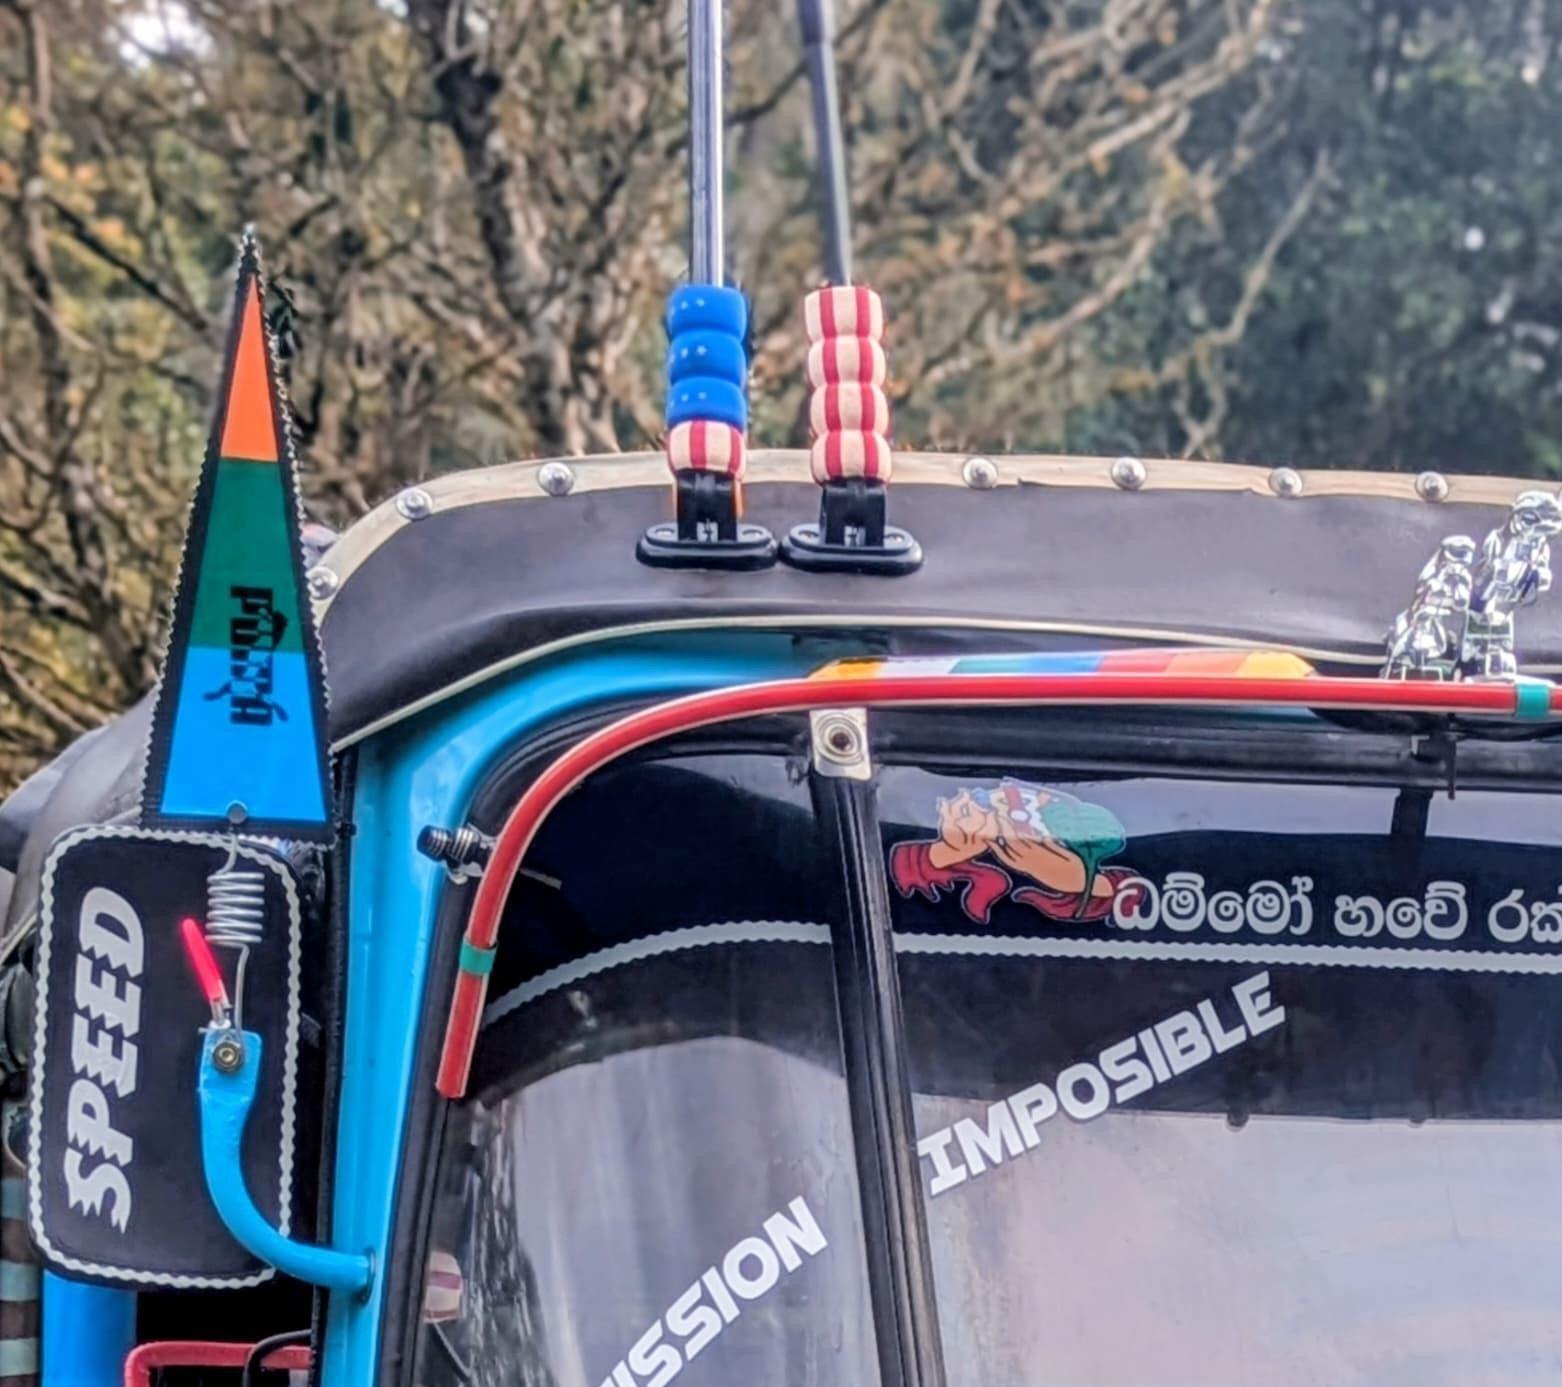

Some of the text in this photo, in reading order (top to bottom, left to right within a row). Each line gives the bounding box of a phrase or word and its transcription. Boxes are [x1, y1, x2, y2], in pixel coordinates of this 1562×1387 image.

[1112, 871, 1315, 935] ධම්මෝ
[1333, 880, 1469, 941] හවේ
[65, 886, 147, 1235] SPEED
[916, 971, 1288, 1198] IMPOSIBLE
